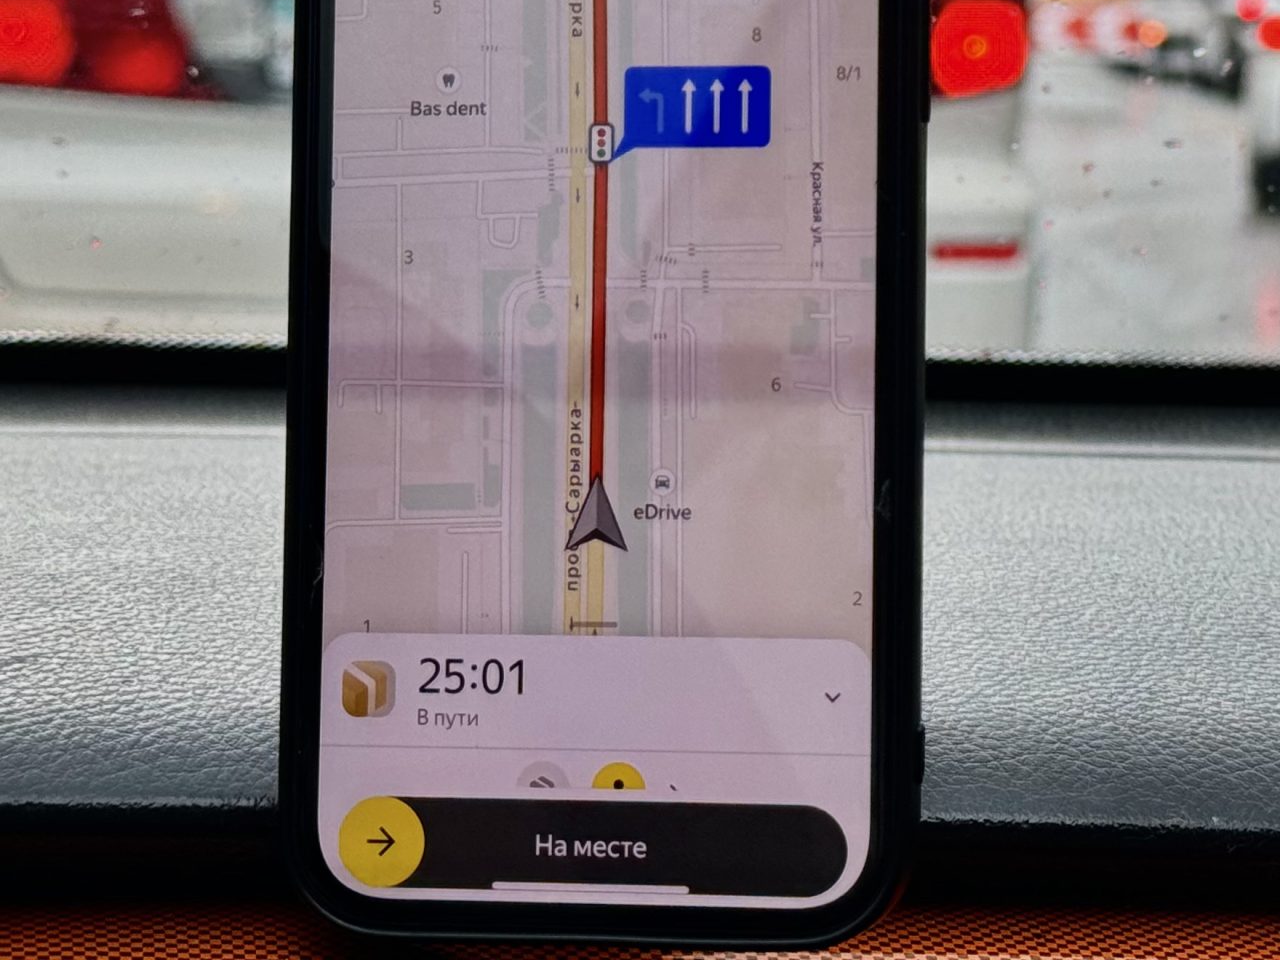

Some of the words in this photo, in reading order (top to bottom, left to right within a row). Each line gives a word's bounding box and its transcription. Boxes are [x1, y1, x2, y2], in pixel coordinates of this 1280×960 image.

[432, 0, 442, 15] 5
[752, 27, 762, 43] 8
[836, 66, 862, 81] 8/1
[410, 100, 442, 116] Bas
[446, 100, 488, 116] dent
[810, 161, 824, 222] Красная
[810, 226, 823, 247] ул.
[404, 249, 414, 265] 3
[771, 376, 782, 392] 6
[566, 406, 583, 514] Сарыарка
[633, 503, 692, 520] eDrive
[852, 591, 863, 606] 2
[418, 657, 524, 695] 25:01
[417, 708, 429, 725] В
[434, 712, 478, 730] пути
[535, 834, 567, 857] На
[573, 840, 648, 859] месте
